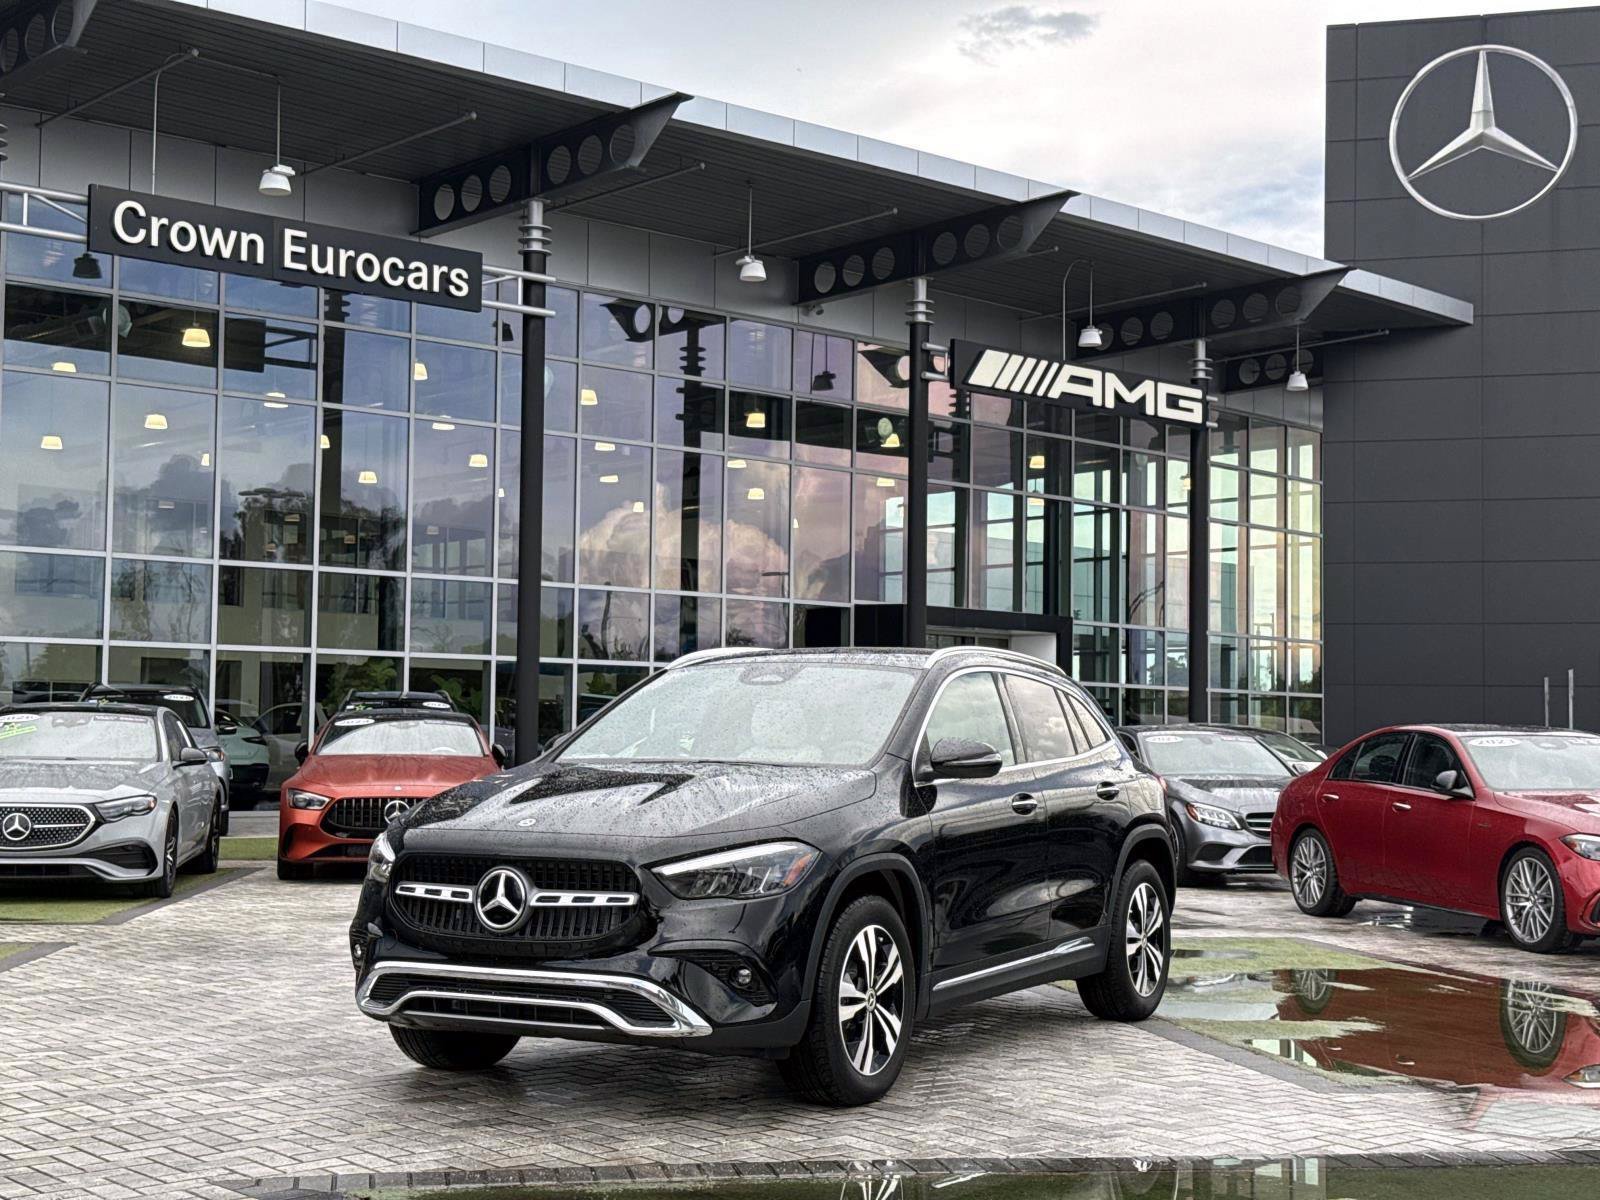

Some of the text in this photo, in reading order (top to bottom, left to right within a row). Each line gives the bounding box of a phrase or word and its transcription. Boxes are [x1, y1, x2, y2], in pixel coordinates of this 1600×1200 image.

[113, 200, 469, 297] Crown Eurocars
[1048, 364, 1203, 424] AMG
